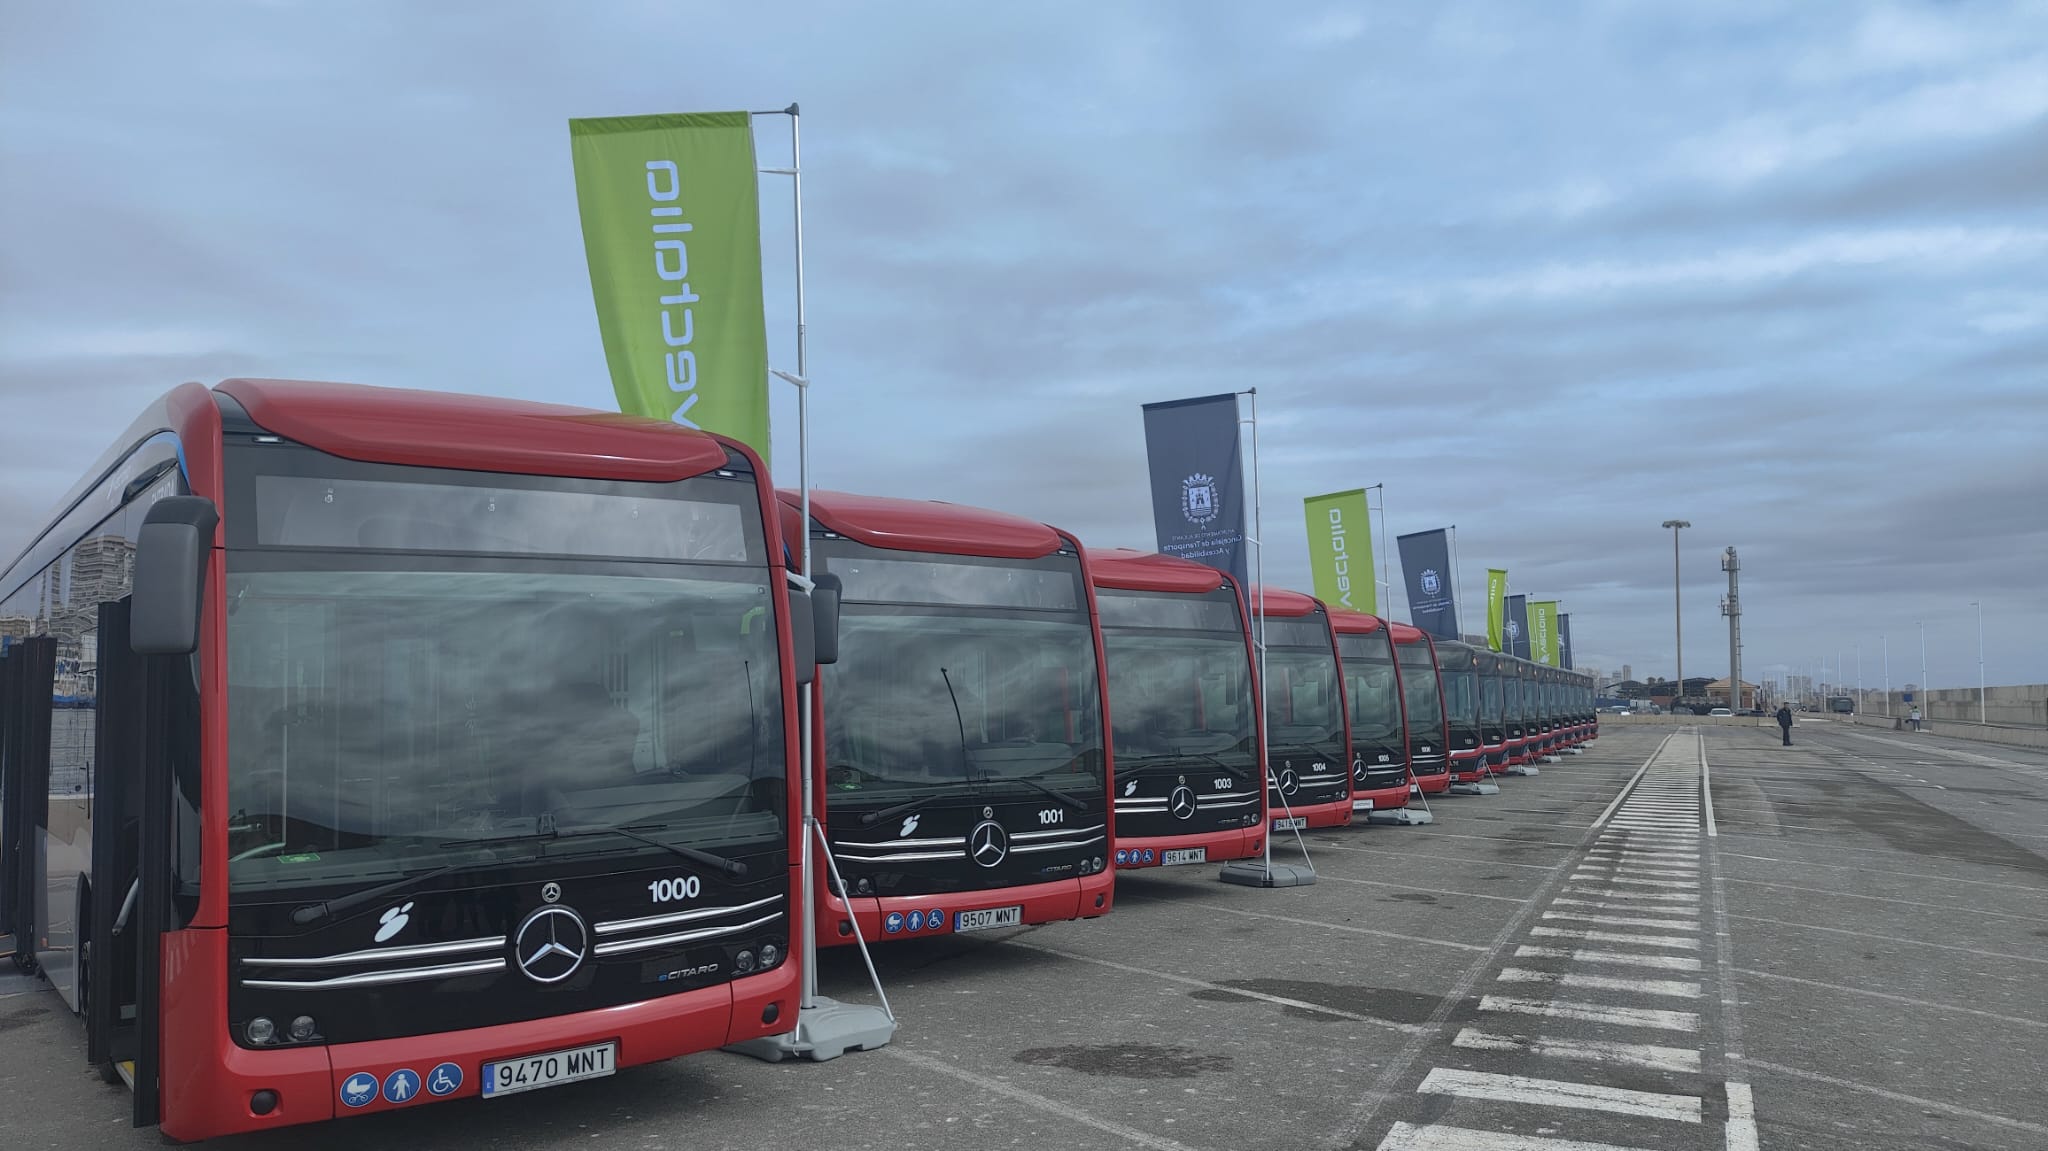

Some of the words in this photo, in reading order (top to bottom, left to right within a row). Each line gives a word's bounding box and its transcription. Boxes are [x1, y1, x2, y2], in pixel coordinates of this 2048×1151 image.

[1312, 762, 1326, 772] 1004
[1214, 777, 1232, 790] 1003
[1038, 808, 1064, 825] 1001
[1166, 850, 1186, 862] 9614
[1189, 849, 1203, 861] MNT
[648, 875, 700, 902] 1000
[962, 911, 991, 928] 9507
[996, 908, 1018, 924] MNT
[500, 1057, 558, 1087] 9470
[567, 1047, 608, 1076] MNT
